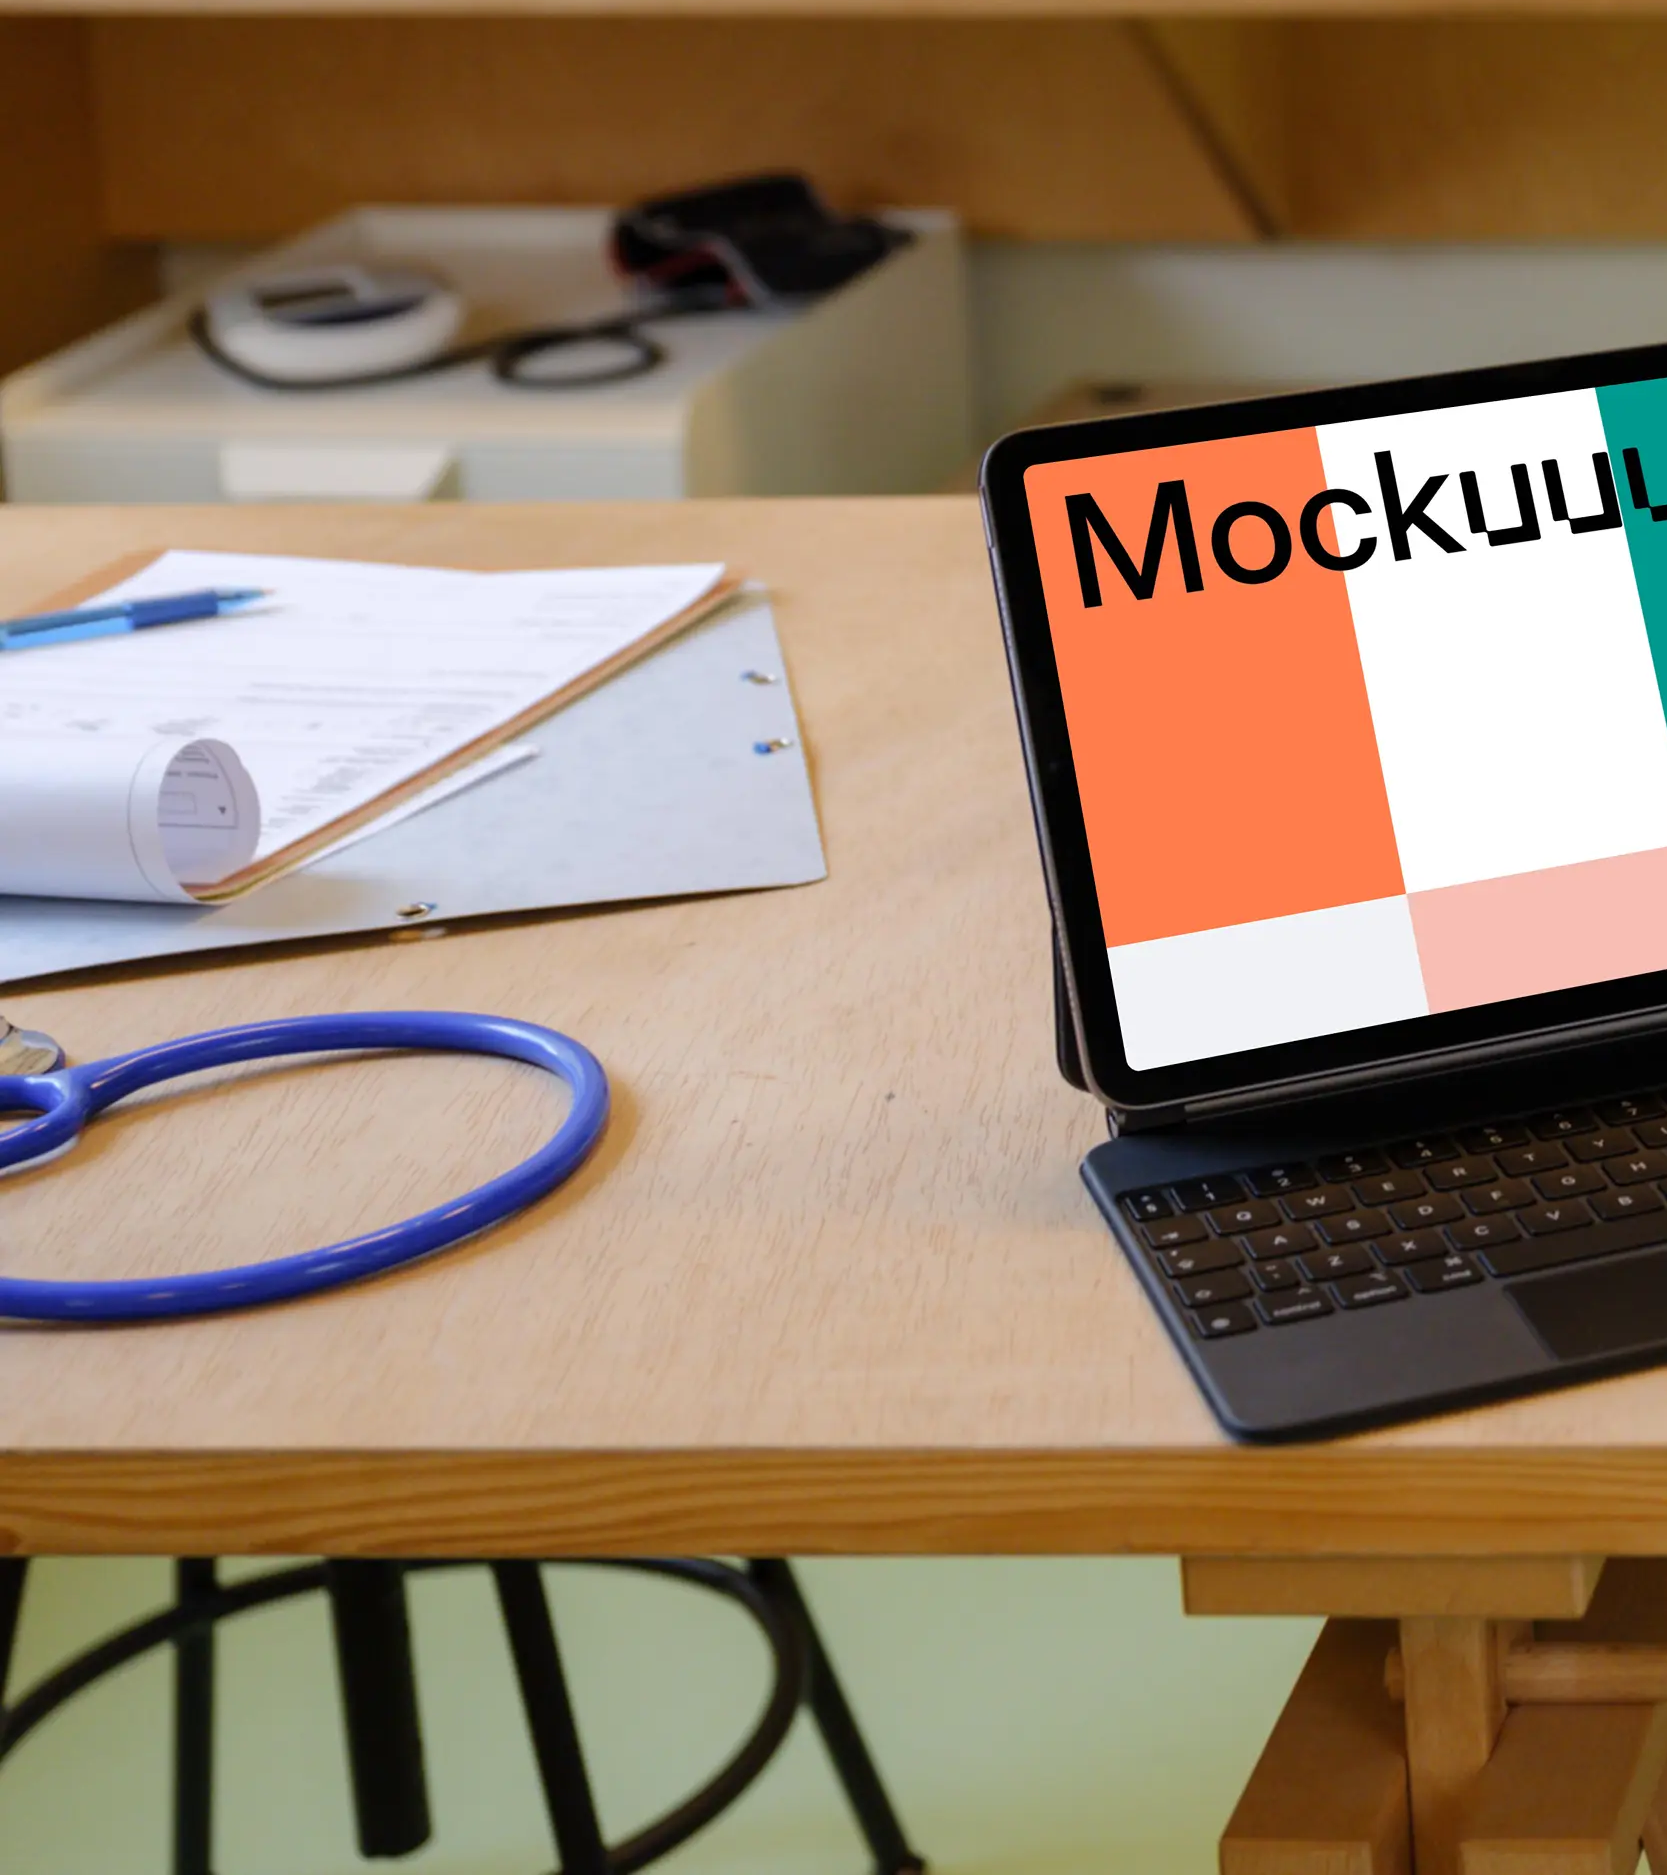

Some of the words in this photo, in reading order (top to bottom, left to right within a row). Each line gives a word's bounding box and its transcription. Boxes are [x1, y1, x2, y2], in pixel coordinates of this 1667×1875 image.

[1273, 1235, 1288, 1246] A
[1417, 1205, 1434, 1216] D
[1630, 1161, 1647, 1172] H
[1305, 1195, 1326, 1207] W
[1523, 1153, 1534, 1162] T
[1593, 1138, 1604, 1148] Y
[1328, 1255, 1343, 1267] Z
[1401, 1240, 1417, 1251] X
[1474, 1225, 1490, 1236] C
[1545, 1209, 1560, 1221] V
